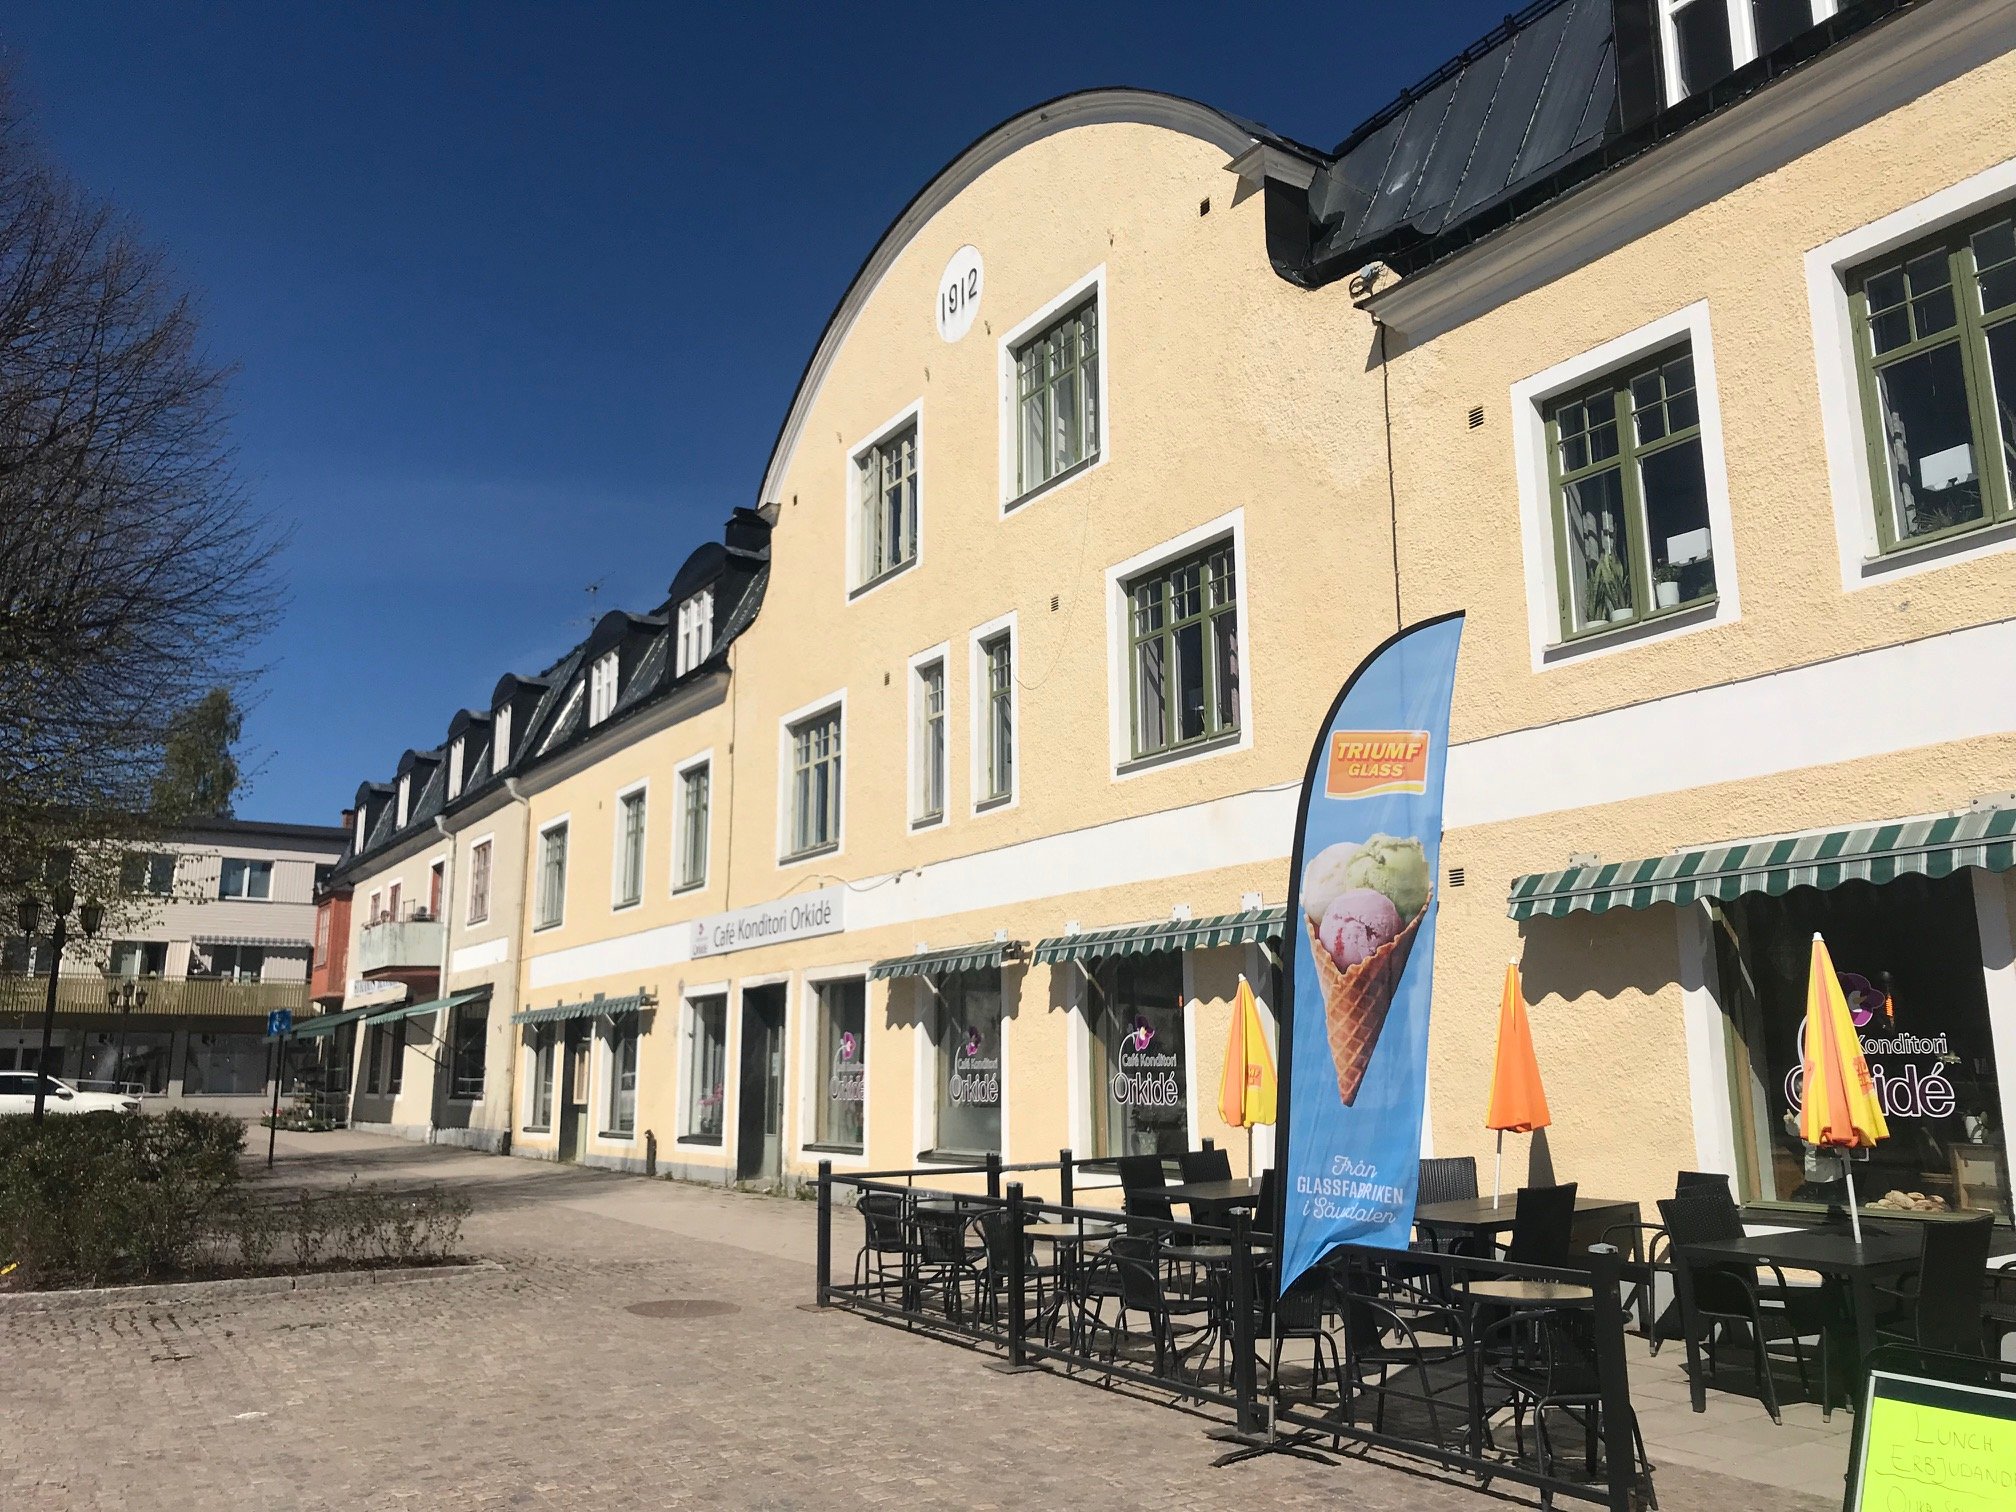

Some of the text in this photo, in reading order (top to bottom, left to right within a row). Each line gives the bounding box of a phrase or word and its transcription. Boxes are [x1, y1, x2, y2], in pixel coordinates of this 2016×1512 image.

[941, 267, 978, 323] 1912
[1337, 742, 1423, 761] TRIUMF
[1347, 763, 1405, 778] GLASS
[713, 899, 832, 948] Café Konditori Orkidé
[957, 1057, 970, 1070] Café
[1121, 1052, 1177, 1068] Café Konditori
[949, 1072, 999, 1103] Orkidé
[1112, 1070, 1179, 1106] Orkidé
[1784, 1061, 1956, 1119] idé
[1331, 1155, 1378, 1179] Från
[1296, 1176, 1405, 1205] GLASSFABRIKEN
[1302, 1199, 1312, 1217] i
[1915, 1410, 1995, 1453] LUNCH
